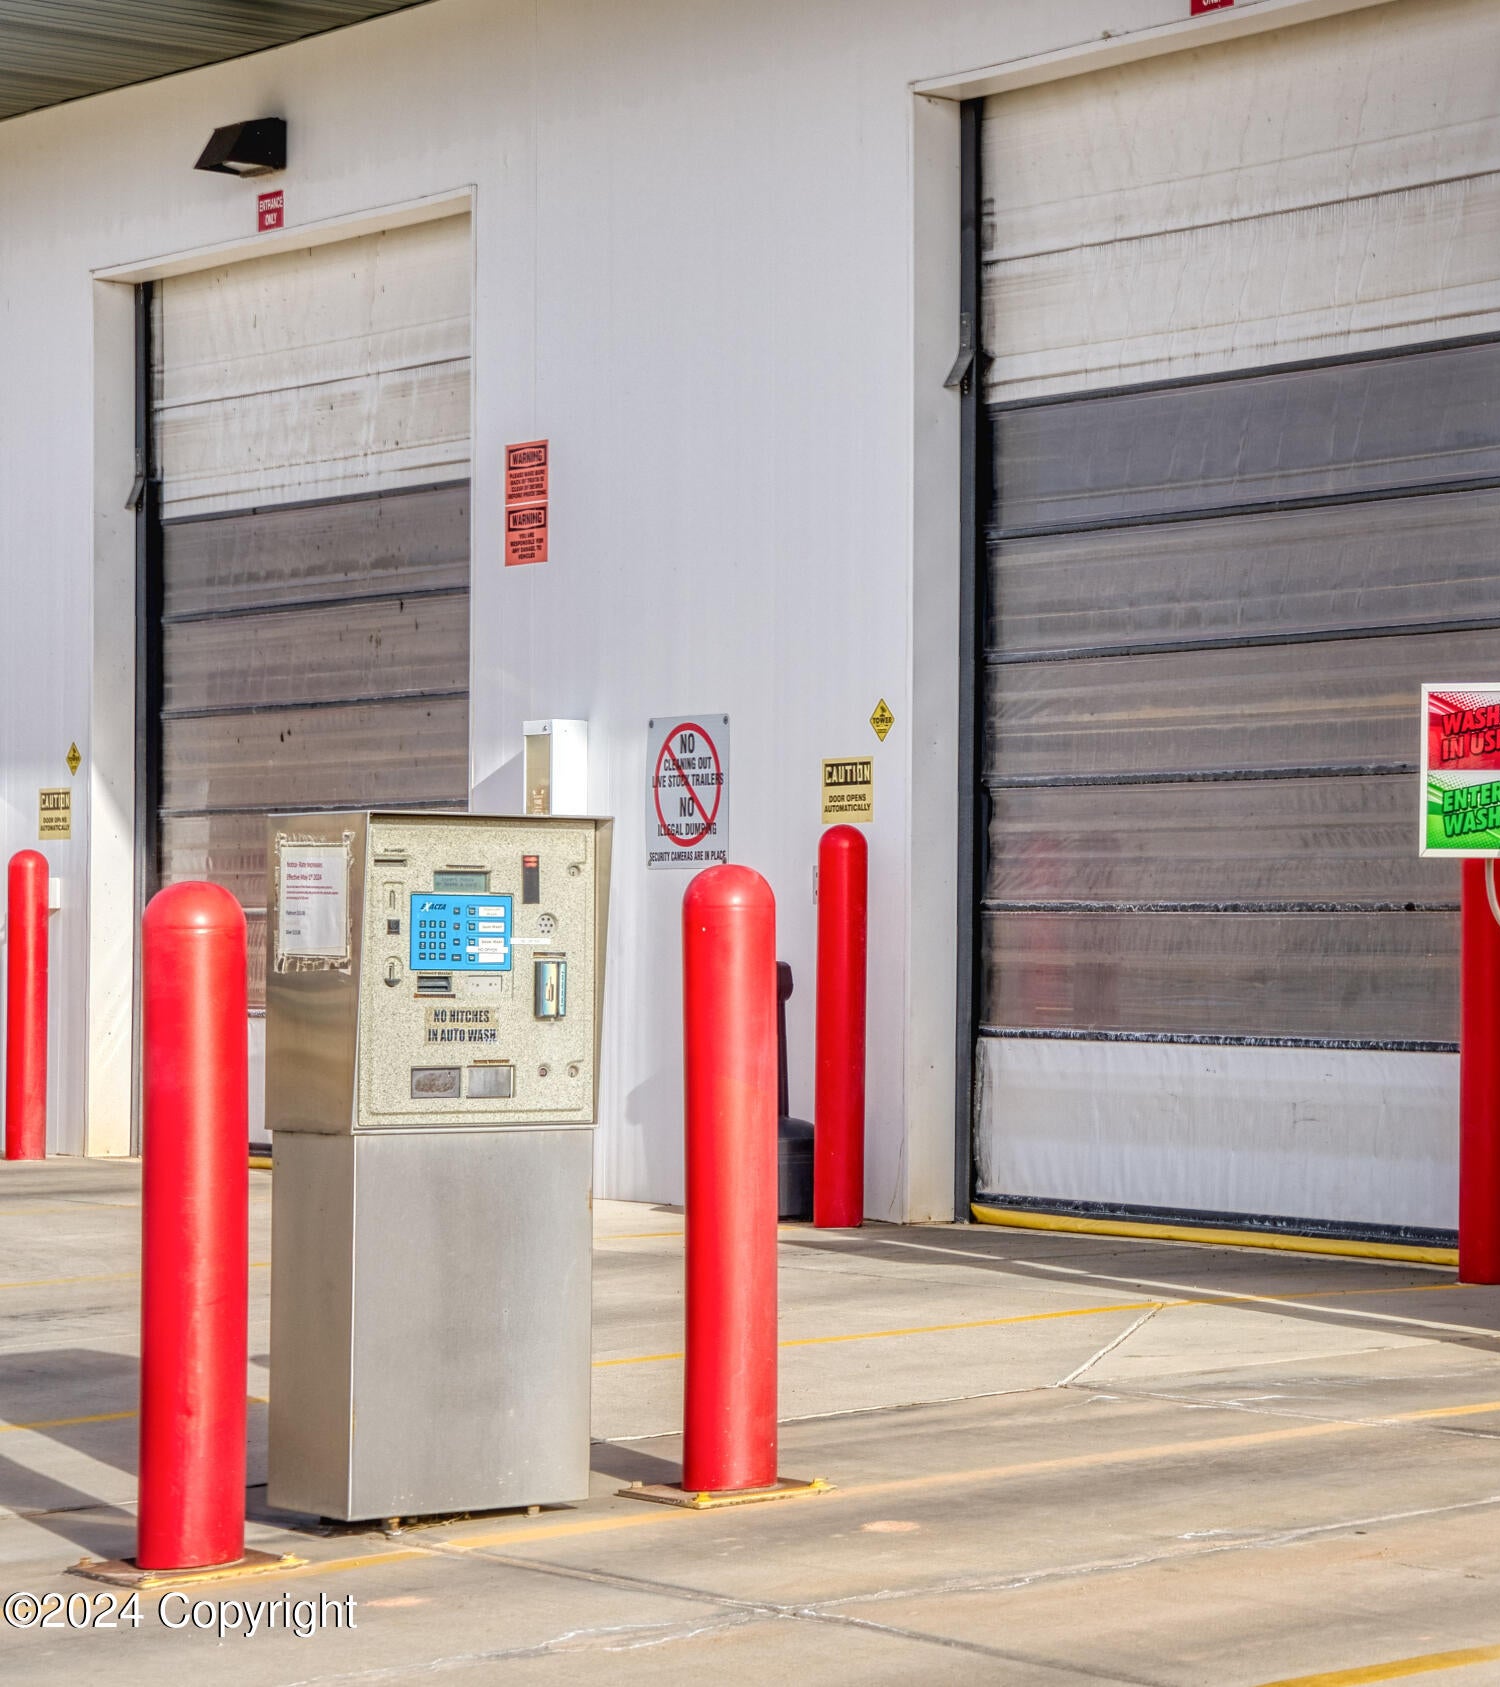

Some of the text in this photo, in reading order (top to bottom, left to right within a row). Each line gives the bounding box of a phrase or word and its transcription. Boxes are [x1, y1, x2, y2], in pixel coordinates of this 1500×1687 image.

[1442, 704, 1500, 737] WASH
[679, 733, 695, 754] NO
[1442, 735, 1465, 763] IN
[664, 756, 712, 771] CLEANING OUT
[668, 774, 690, 788] STOCK
[692, 773, 724, 787] TRAILERS
[826, 764, 871, 783] CAUTION
[829, 793, 867, 803] DOOR OPENS
[679, 797, 695, 817] NO
[824, 803, 871, 813] AUTOMATICALLY
[658, 822, 717, 837] ILLEGAL DUMPING
[649, 850, 726, 862] SECURITY CAMERAS ARE IN PLACE
[434, 1009, 490, 1023] NO HITCHES
[428, 1028, 496, 1042] IN AUTO WASH
